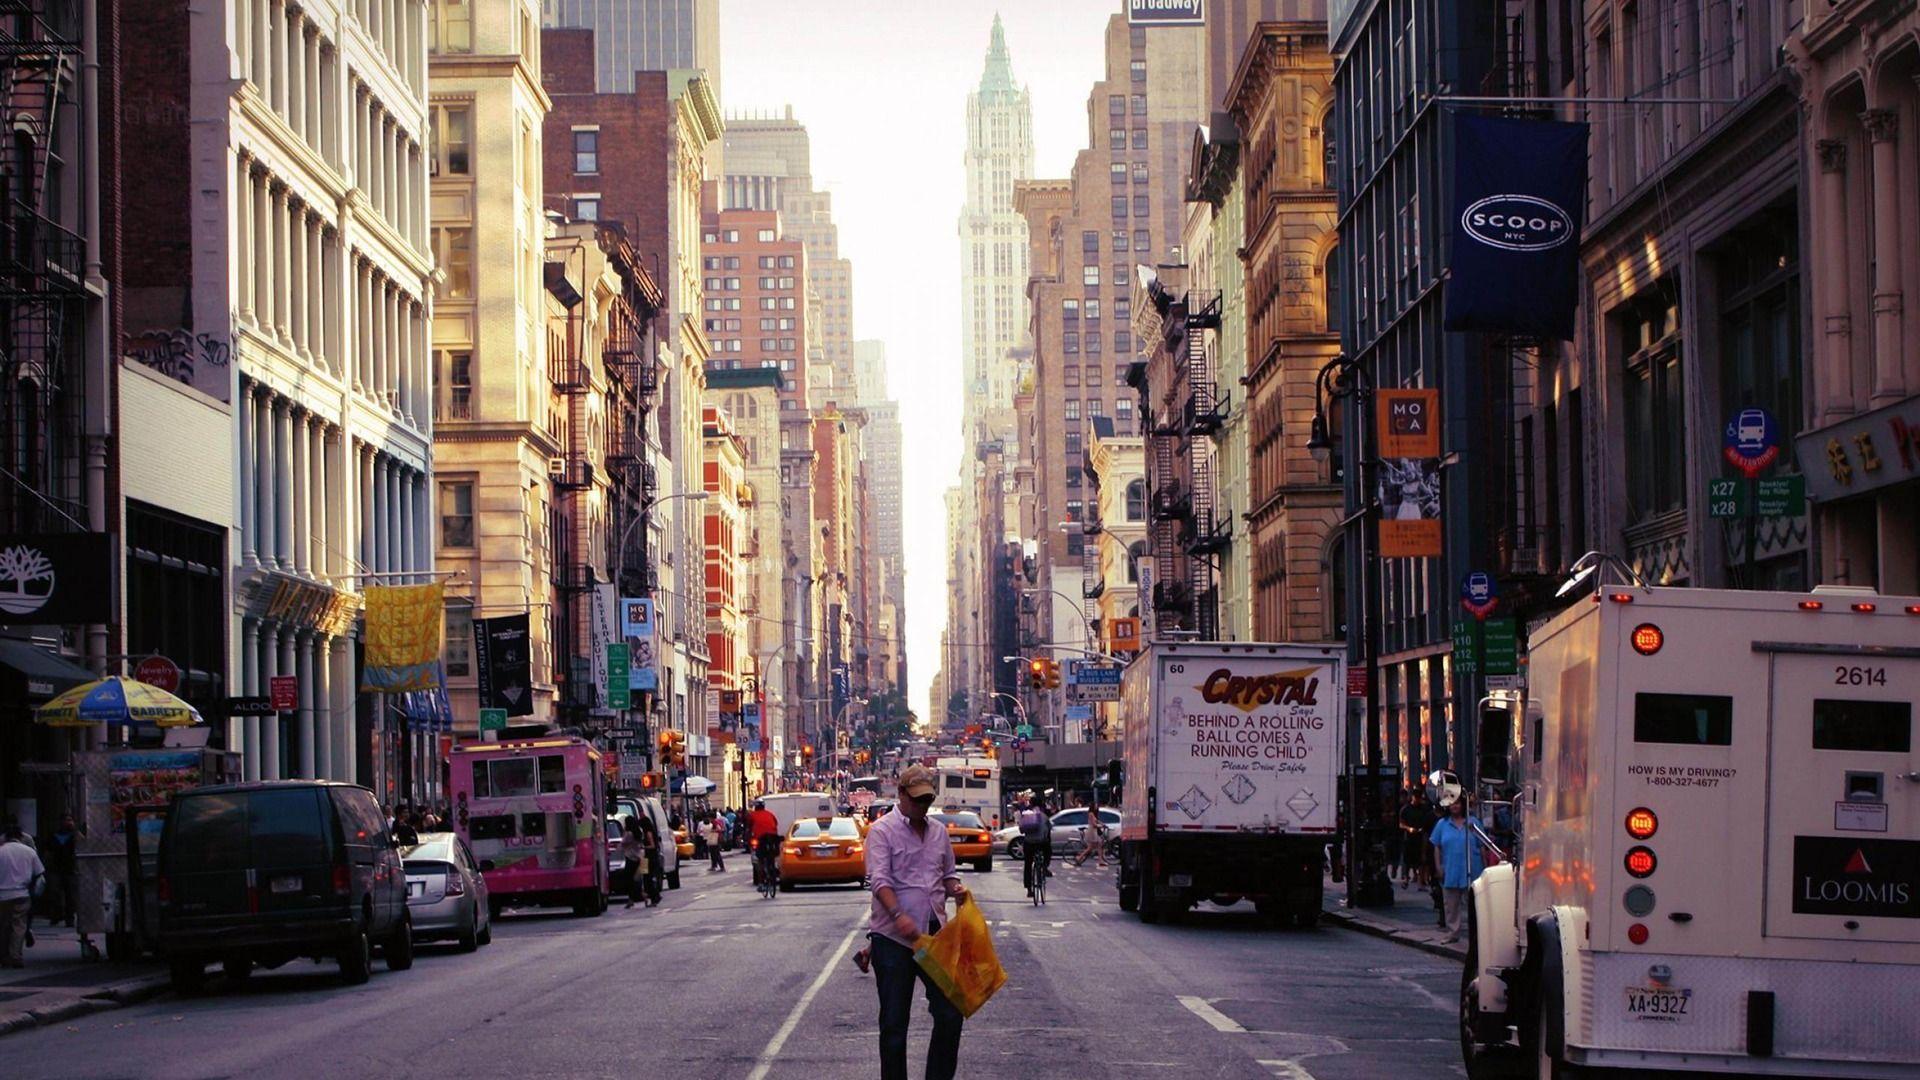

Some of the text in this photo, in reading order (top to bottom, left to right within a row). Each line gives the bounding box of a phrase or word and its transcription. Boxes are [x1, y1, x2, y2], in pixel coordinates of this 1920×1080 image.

[1132, 0, 1201, 15] Broadway
[1473, 213, 1561, 232] SCOOP
[1504, 232, 1526, 240] NYC
[139, 665, 173, 676] Jewelry
[1169, 665, 1184, 674] 60
[1835, 666, 1887, 686] 2614
[1201, 668, 1319, 706] CRYSTAL
[131, 707, 183, 717] SABRETT
[234, 702, 271, 711] ALDO
[1244, 716, 1255, 728] A
[1260, 716, 1324, 730] ROLLING
[1196, 730, 1306, 744] BALL COMES A
[1191, 745, 1258, 758] RUNNING
[1221, 761, 1307, 773] Please Drive Safely
[1627, 765, 1737, 778] HOW IS MY DRIVING?
[504, 836, 544, 848] YOGO
[1804, 876, 1910, 904] LOOMIS
